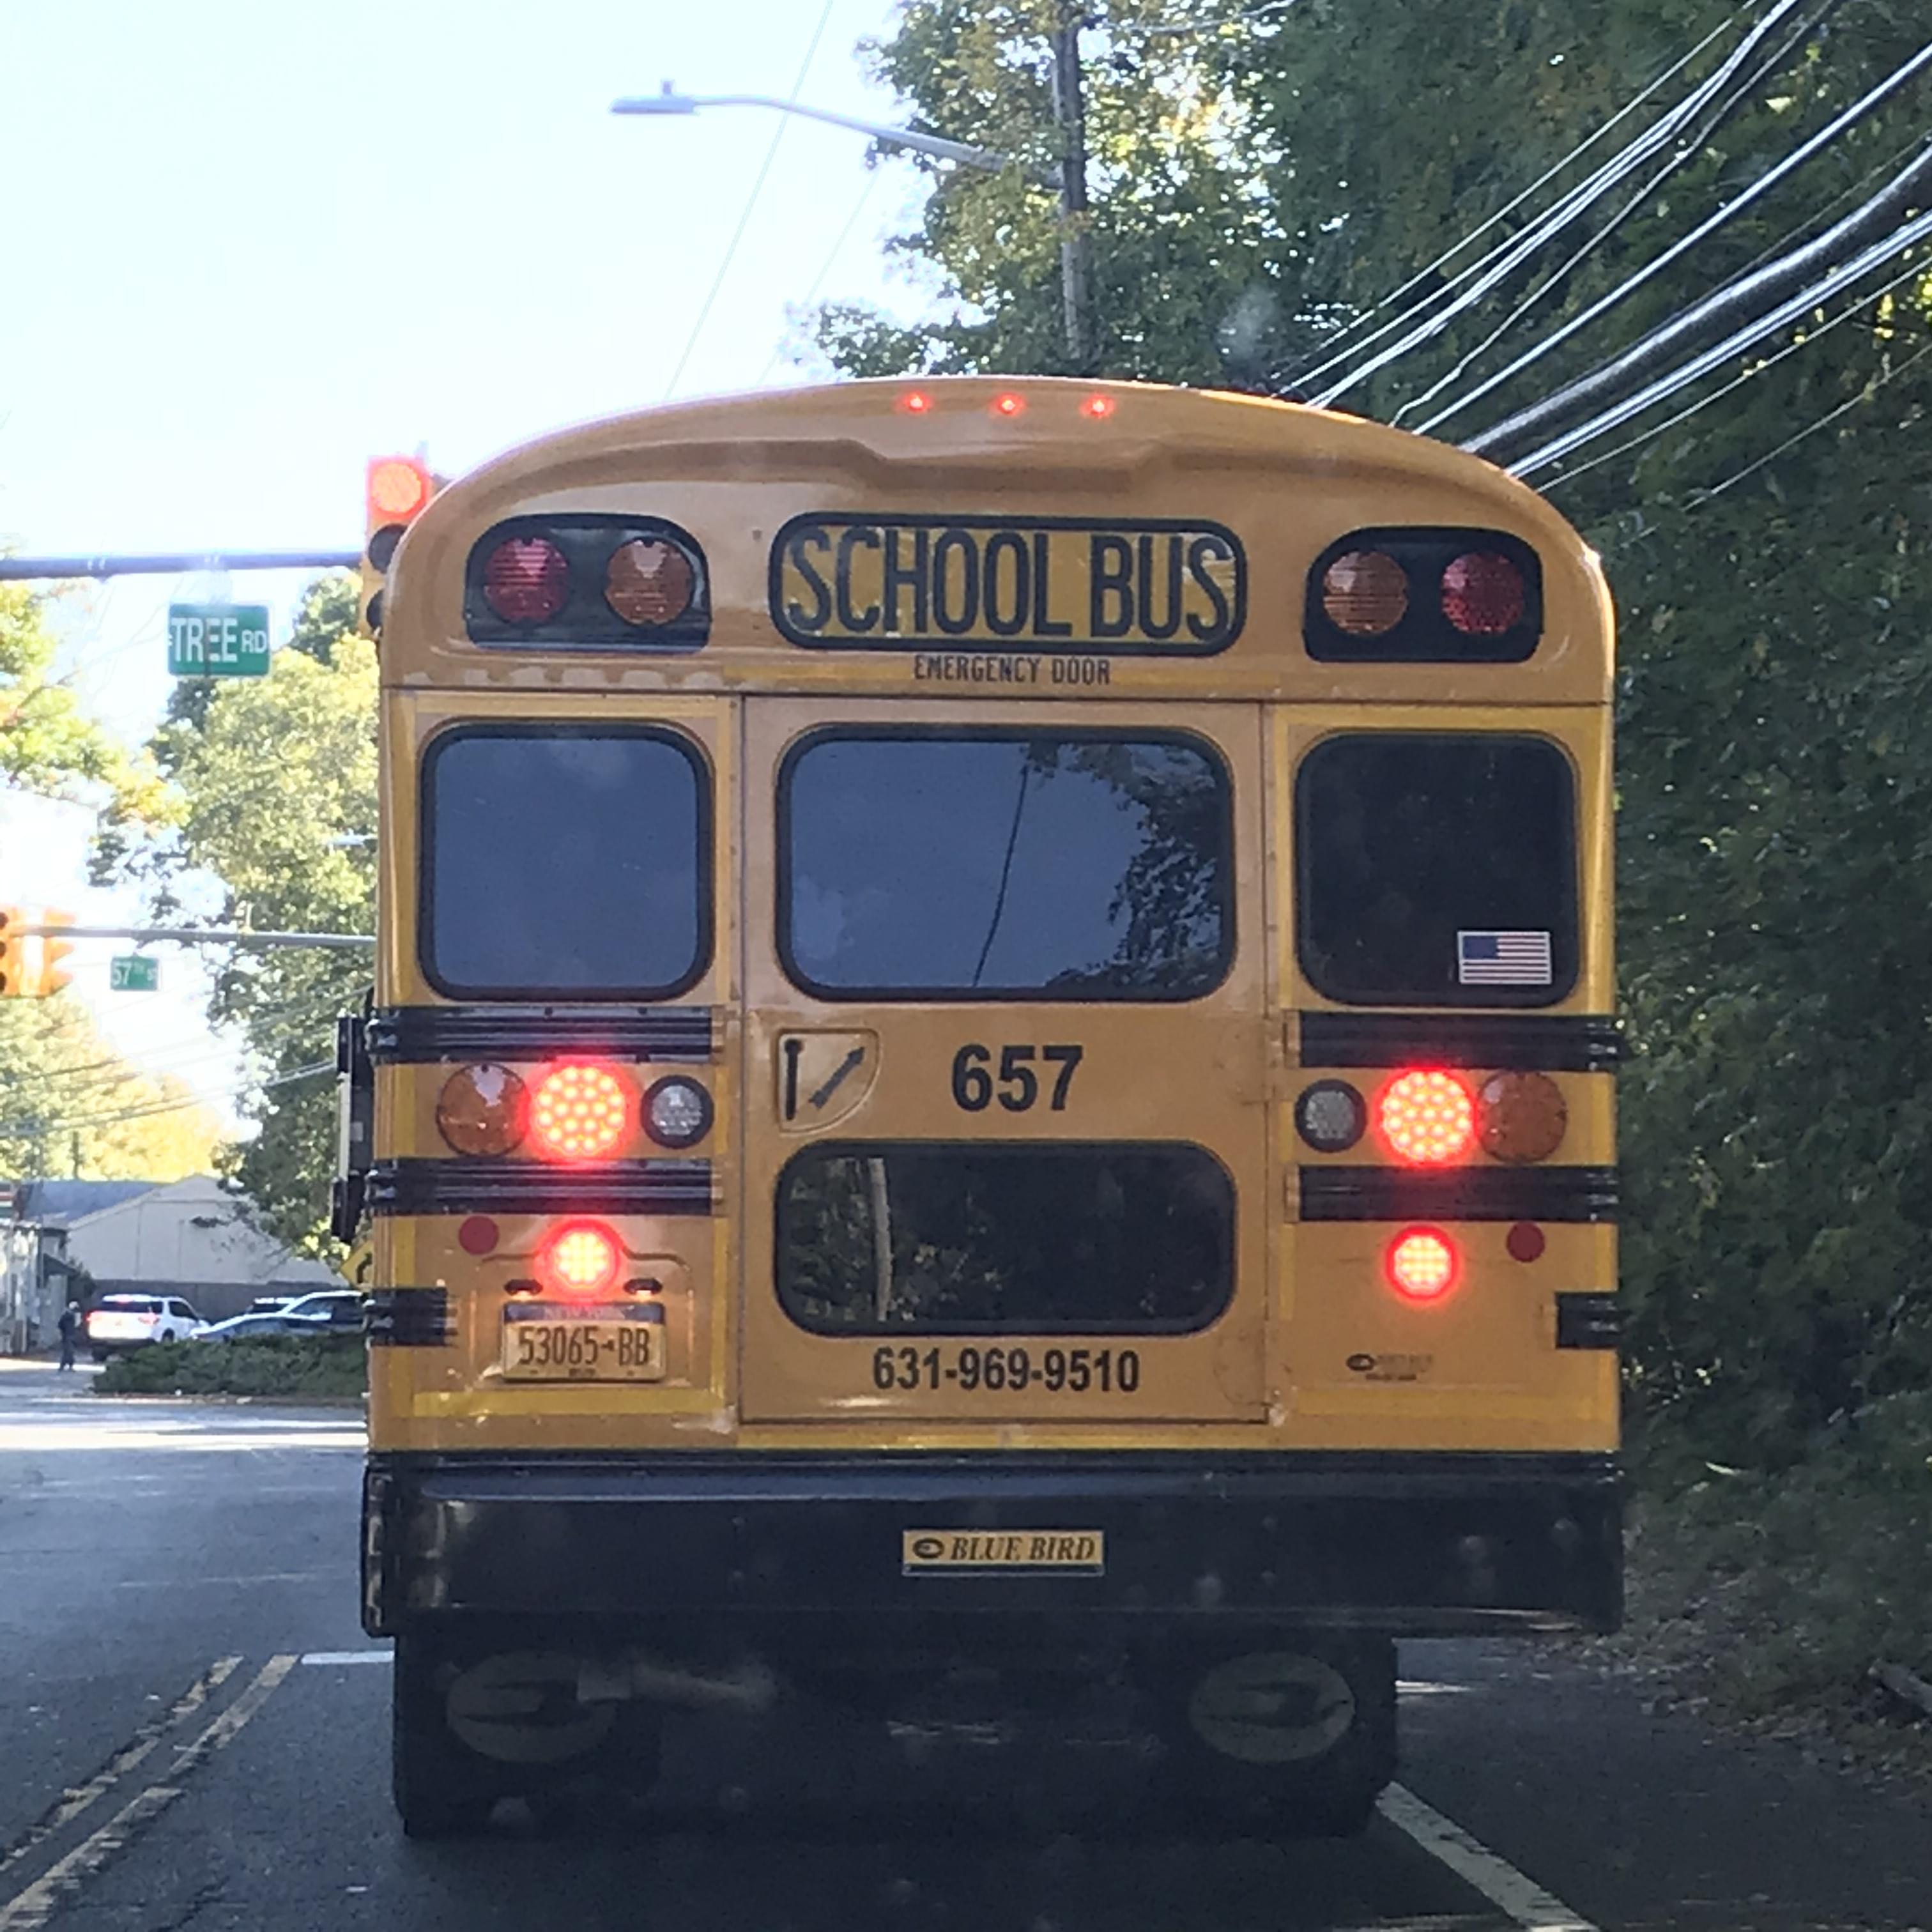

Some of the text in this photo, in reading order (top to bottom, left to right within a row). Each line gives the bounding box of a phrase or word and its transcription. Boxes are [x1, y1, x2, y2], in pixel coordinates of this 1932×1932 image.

[788, 525, 1230, 641] SCHOOL BUS
[241, 629, 267, 654] RD
[914, 654, 1110, 685] EMERGENCY DOOR
[952, 1043, 1083, 1112] 657
[873, 1346, 1140, 1392] 631-969-9510
[950, 1537, 1095, 1561] BLUE BIRD
